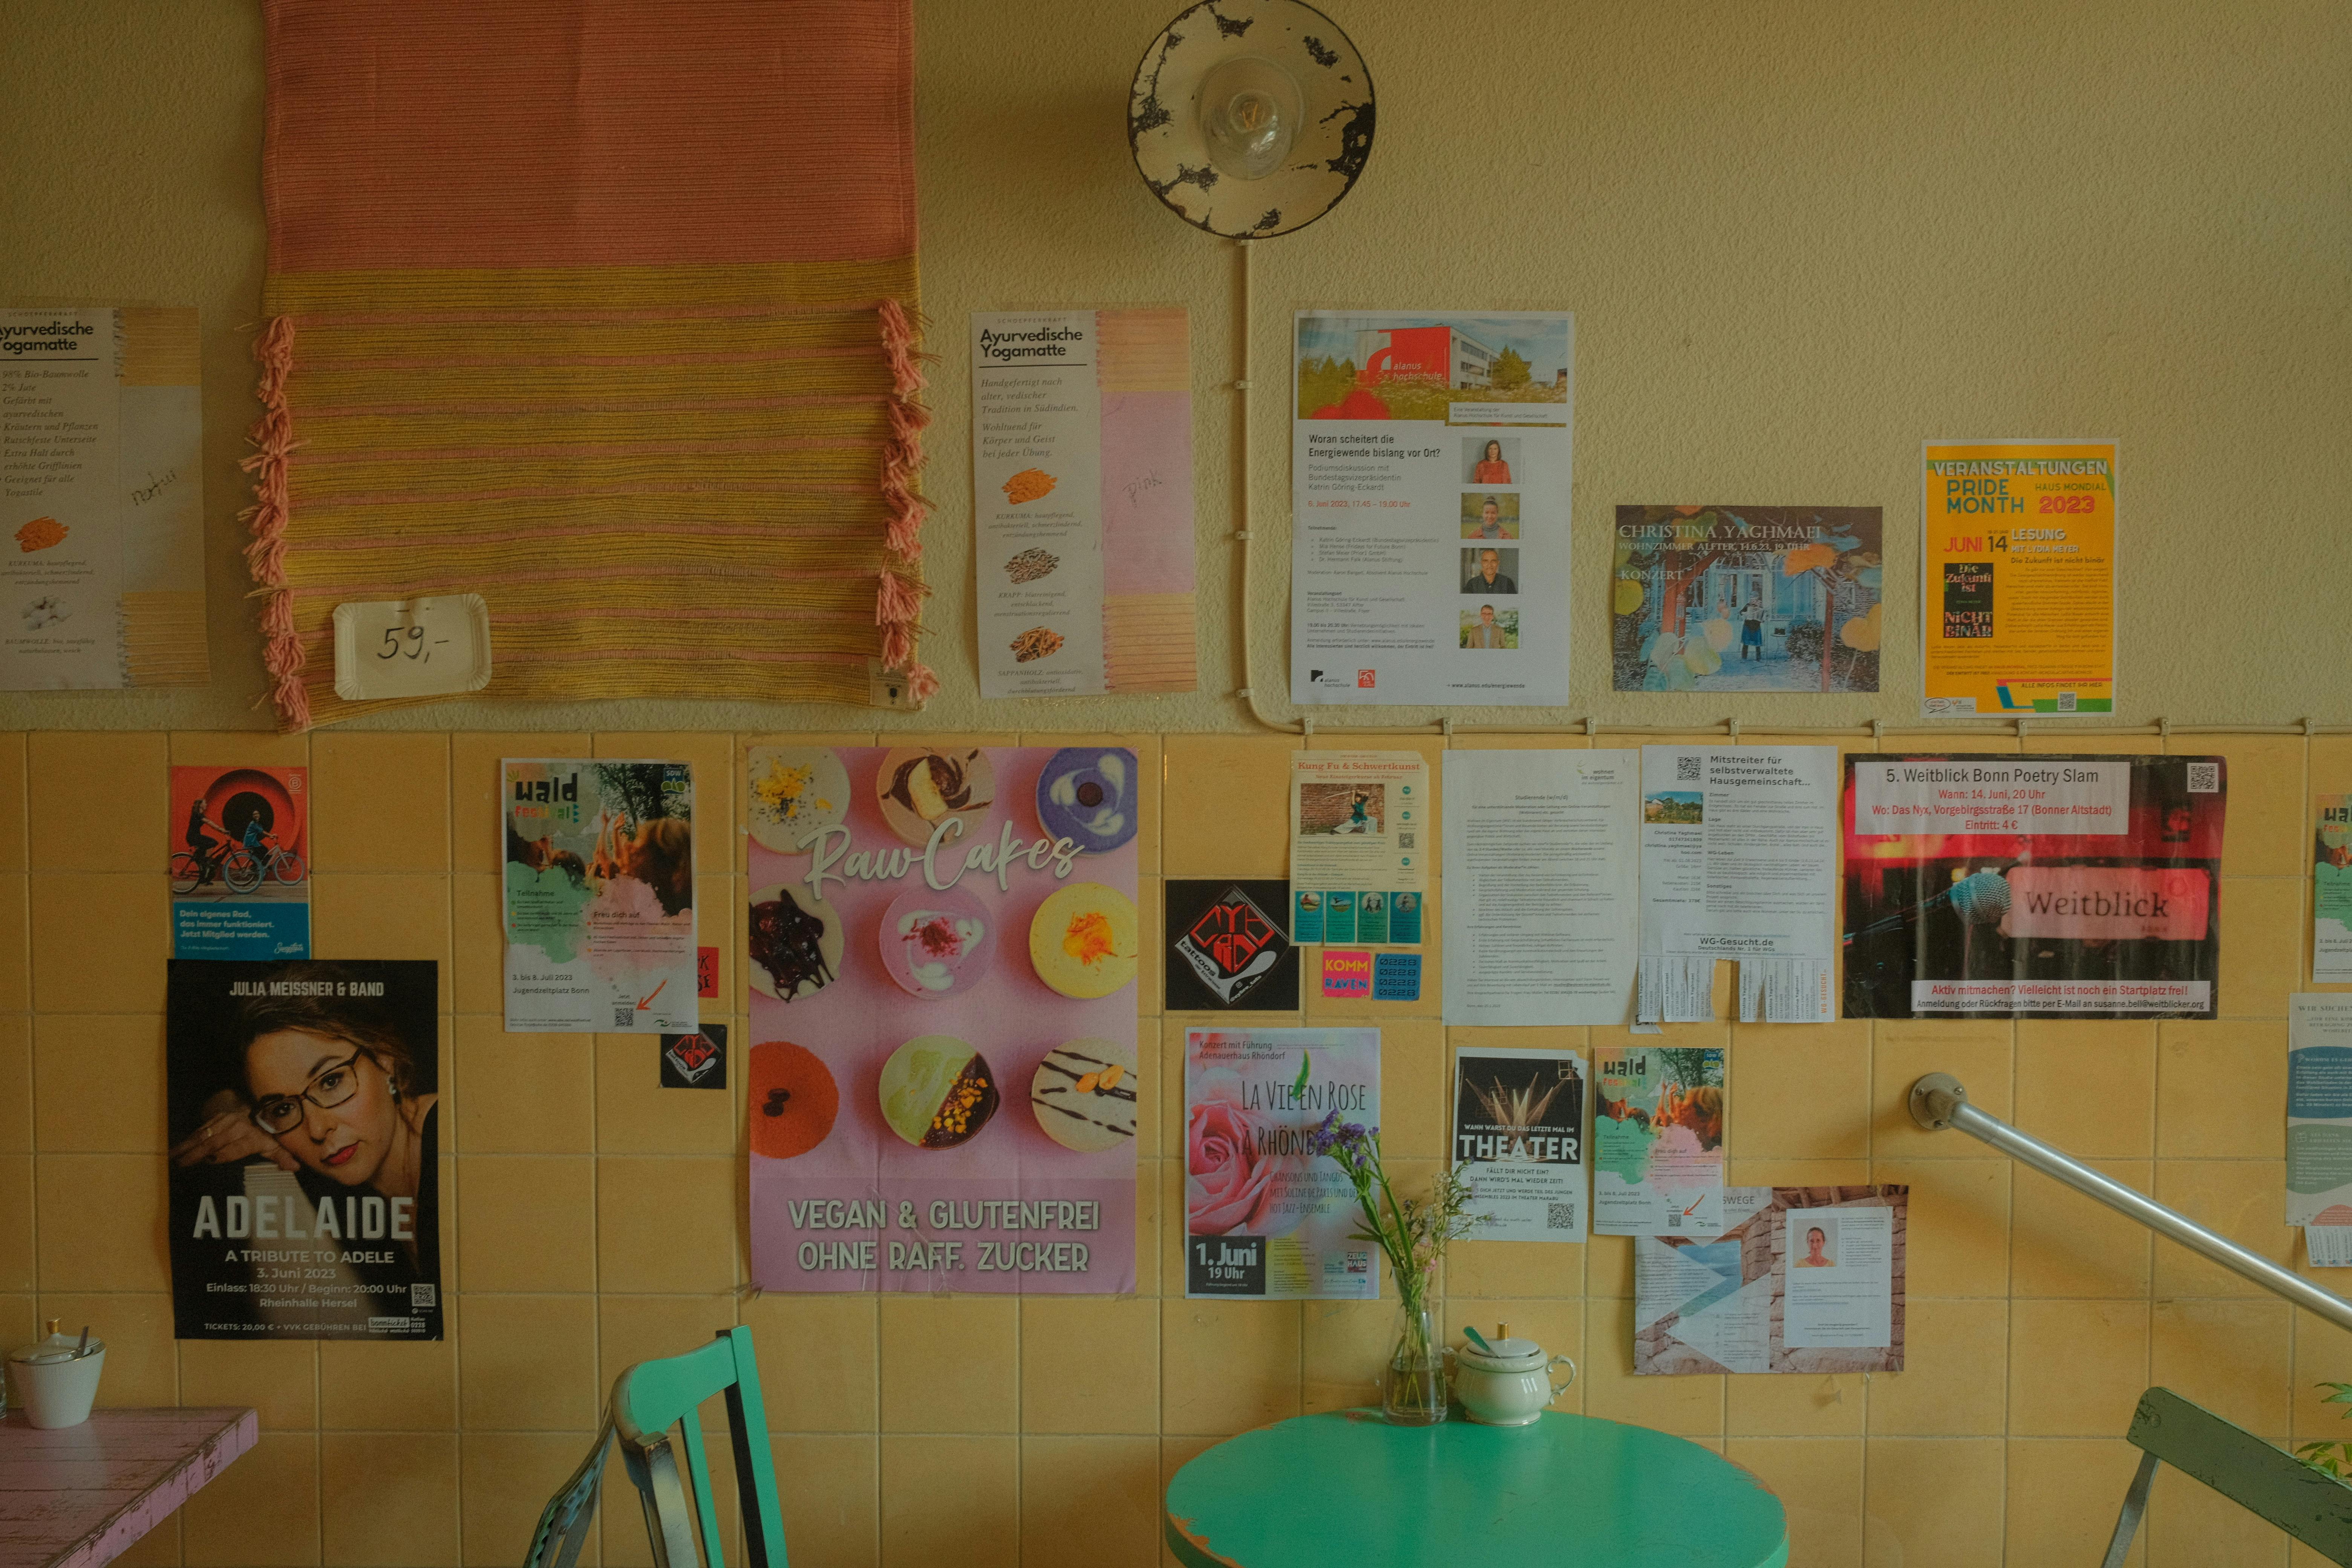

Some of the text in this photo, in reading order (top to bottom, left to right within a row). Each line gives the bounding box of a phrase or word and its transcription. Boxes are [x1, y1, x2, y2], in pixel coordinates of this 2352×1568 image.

[980, 326, 1083, 346] Ayurvedische
[0, 337, 78, 355] ogamatte
[980, 343, 1066, 361] Yogamatte
[1393, 362, 1421, 370] alanus
[1393, 371, 1442, 381] hochschule
[980, 378, 1040, 389] Handgefertigt
[981, 405, 1021, 415] Tradition
[1034, 404, 1078, 413] Südindien.
[1309, 434, 1394, 444] Woran scheitert die
[1309, 447, 1370, 459] Energiewende
[1373, 448, 1405, 459] bislang
[1424, 448, 1441, 458] Ort?
[1934, 460, 2107, 476] VERANSTALTUNGEN
[1947, 479, 2009, 496] PRIDE
[2035, 481, 2106, 491] HAUS MONDIAL
[1947, 496, 2024, 514] MONTH
[2040, 495, 2095, 514] 2023
[1724, 525, 1821, 539] YAGHMAEI
[2012, 528, 2066, 540] LESUNG
[1619, 542, 1694, 551] WOHNZIMMER
[1787, 542, 1810, 551] UHR
[1943, 535, 2008, 553] JUNI 14
[1620, 570, 1684, 580] KONZERT
[377, 626, 450, 665] 59,-
[1710, 756, 1764, 764] Mitstreiter
[1297, 762, 1325, 772] Kung
[1710, 766, 1793, 775] selbstverwaltete
[1710, 777, 1810, 787] Hausgemeinschaft...
[1886, 768, 2099, 786] 5. Weitblick Bonn Poetry Slam
[516, 773, 578, 803] wald
[1938, 789, 2046, 801] Wann: 14. Juni, 20 Uhr
[1872, 804, 2113, 817] Wo: Das Nyx, Vorgebirgsstraße 17 (Bonner Altstadt)
[1966, 820, 2018, 830] Eintritt: 4 €
[796, 817, 1085, 900] Raw Cakes
[2026, 891, 2169, 917] Weitblick
[200, 911, 231, 919] eigenes
[232, 910, 251, 919] Rad,
[1700, 937, 1774, 946] WG-Gesucht.de
[1325, 959, 1369, 972] KOMM
[230, 981, 384, 996] JULIA MEISSNER & BAND
[1325, 978, 1367, 990] RAVEN
[1931, 985, 2188, 997] Aktiv mitmachen? Vielleicht ist noch ein Startplatz frei!
[1199, 1040, 1227, 1049] Konzert
[1243, 1041, 1271, 1050] Führung
[1604, 1055, 1646, 1076] wald
[1459, 1135, 1578, 1160] THEATER
[193, 1194, 414, 1240] ADELAIDE
[787, 1200, 1099, 1230] VEGAN & GLUTENFREI
[225, 1250, 394, 1264] A TRIBUTE TO ADELE
[798, 1242, 1088, 1271] OHNE RAFF. ZUCKER
[1196, 1243, 1214, 1266] 1.
[1217, 1242, 1257, 1266] Juni
[257, 1267, 337, 1279] 3. Juni 2023
[1208, 1267, 1245, 1279] 19 Uhr
[206, 1283, 247, 1293] Einlass:
[250, 1283, 276, 1293] 18:30
[279, 1284, 299, 1293] Uhr
[309, 1284, 351, 1295] Beginn:
[353, 1285, 384, 1294] 20:00
[386, 1285, 407, 1294] Uhr
[260, 1298, 357, 1308] Rheinhalle Hersel
